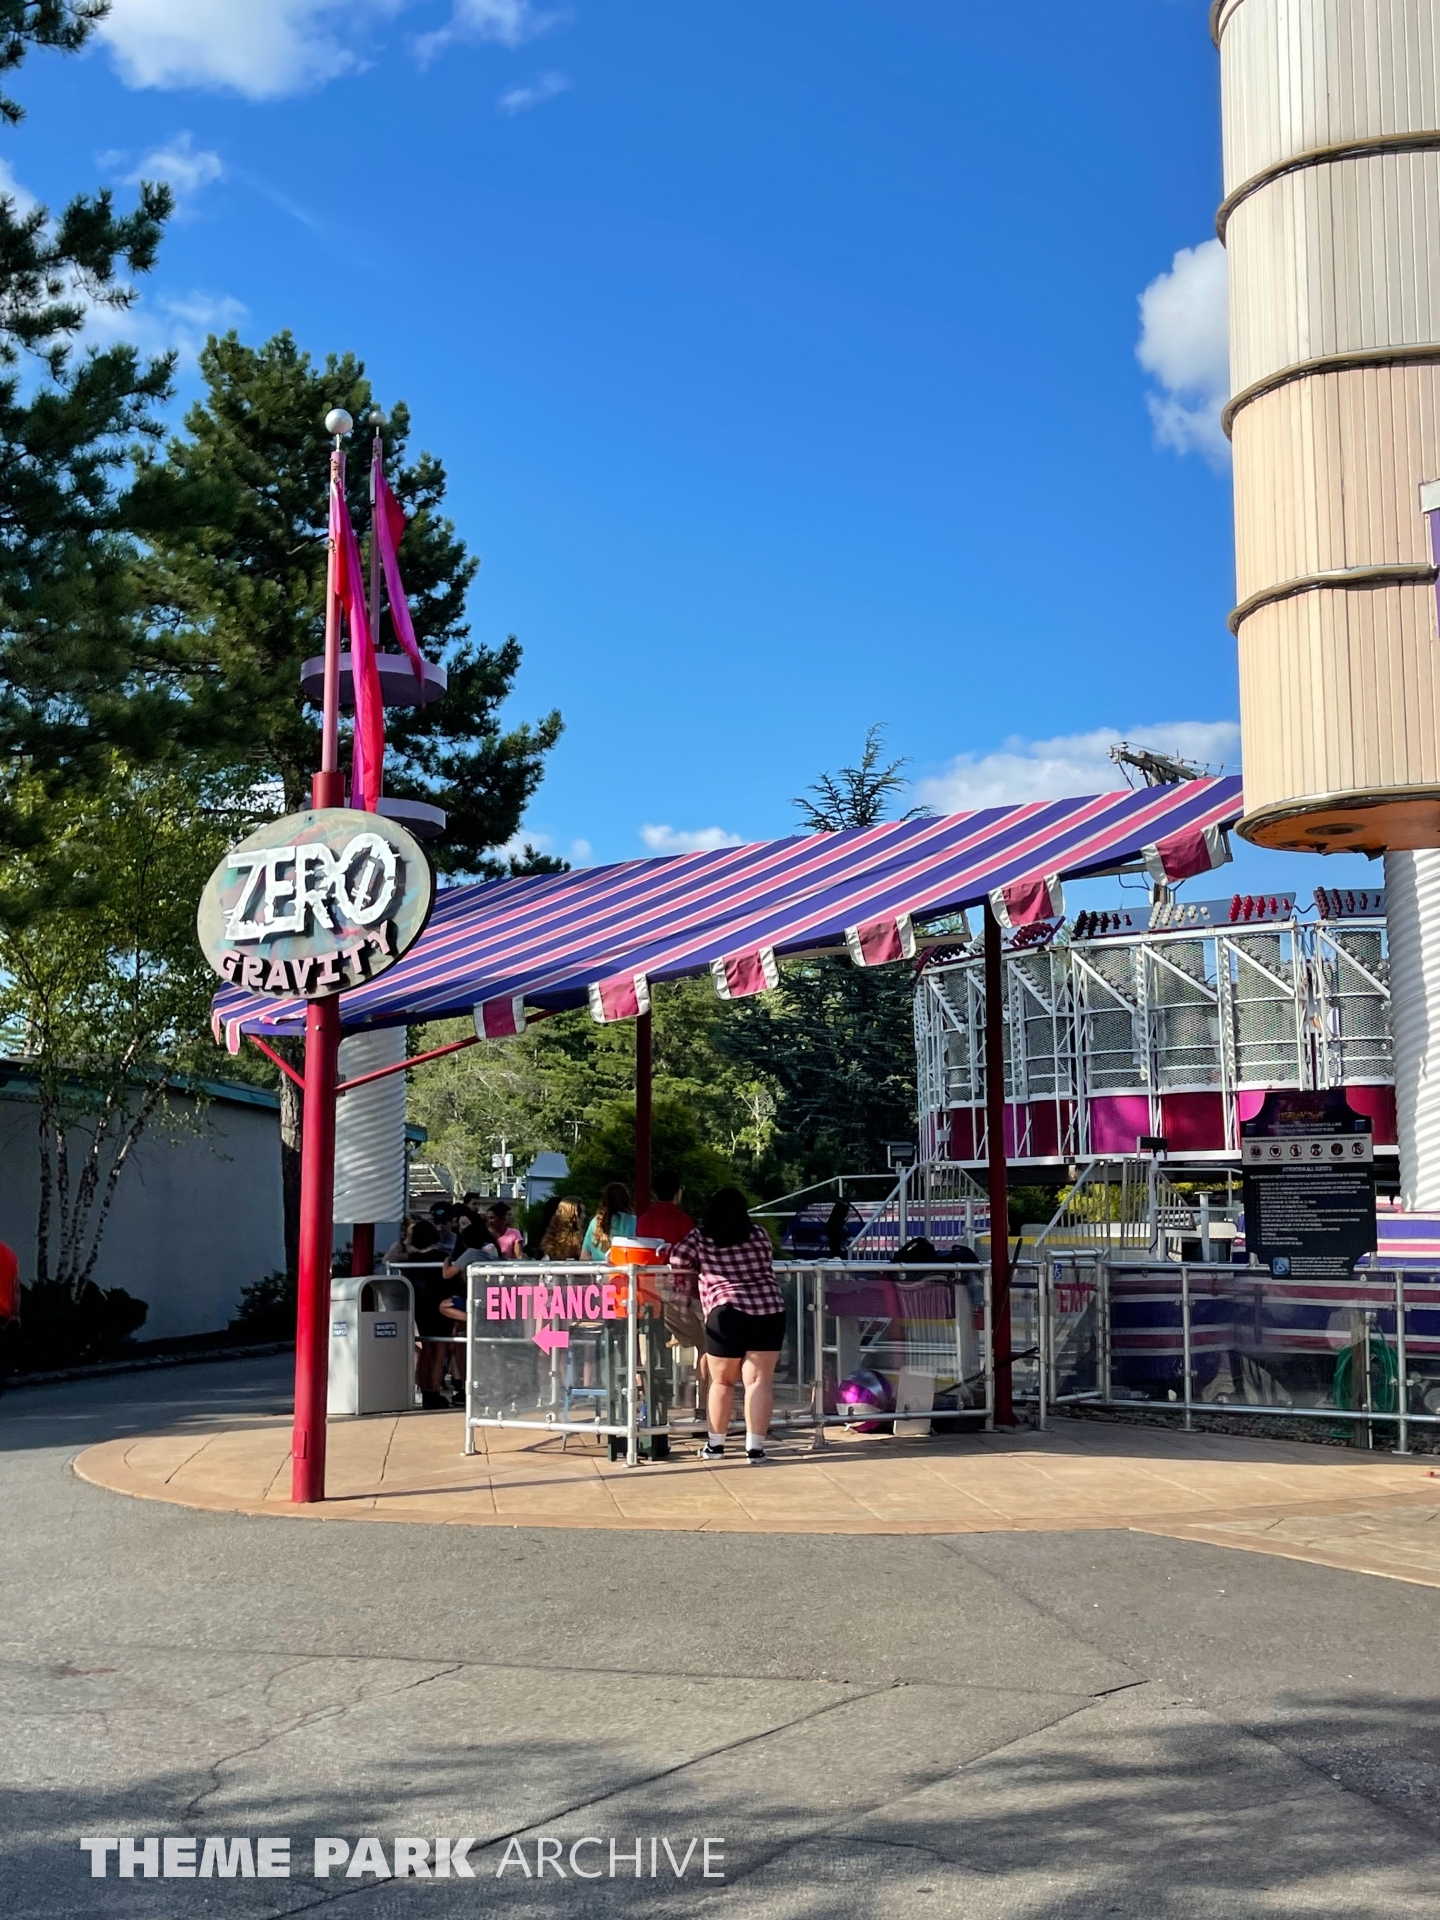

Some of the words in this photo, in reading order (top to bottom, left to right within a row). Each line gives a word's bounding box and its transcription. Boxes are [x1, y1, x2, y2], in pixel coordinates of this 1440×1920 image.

[222, 832, 400, 943] ZERO
[218, 920, 391, 990] GRAVITY
[486, 1284, 616, 1321] ENTRANCE
